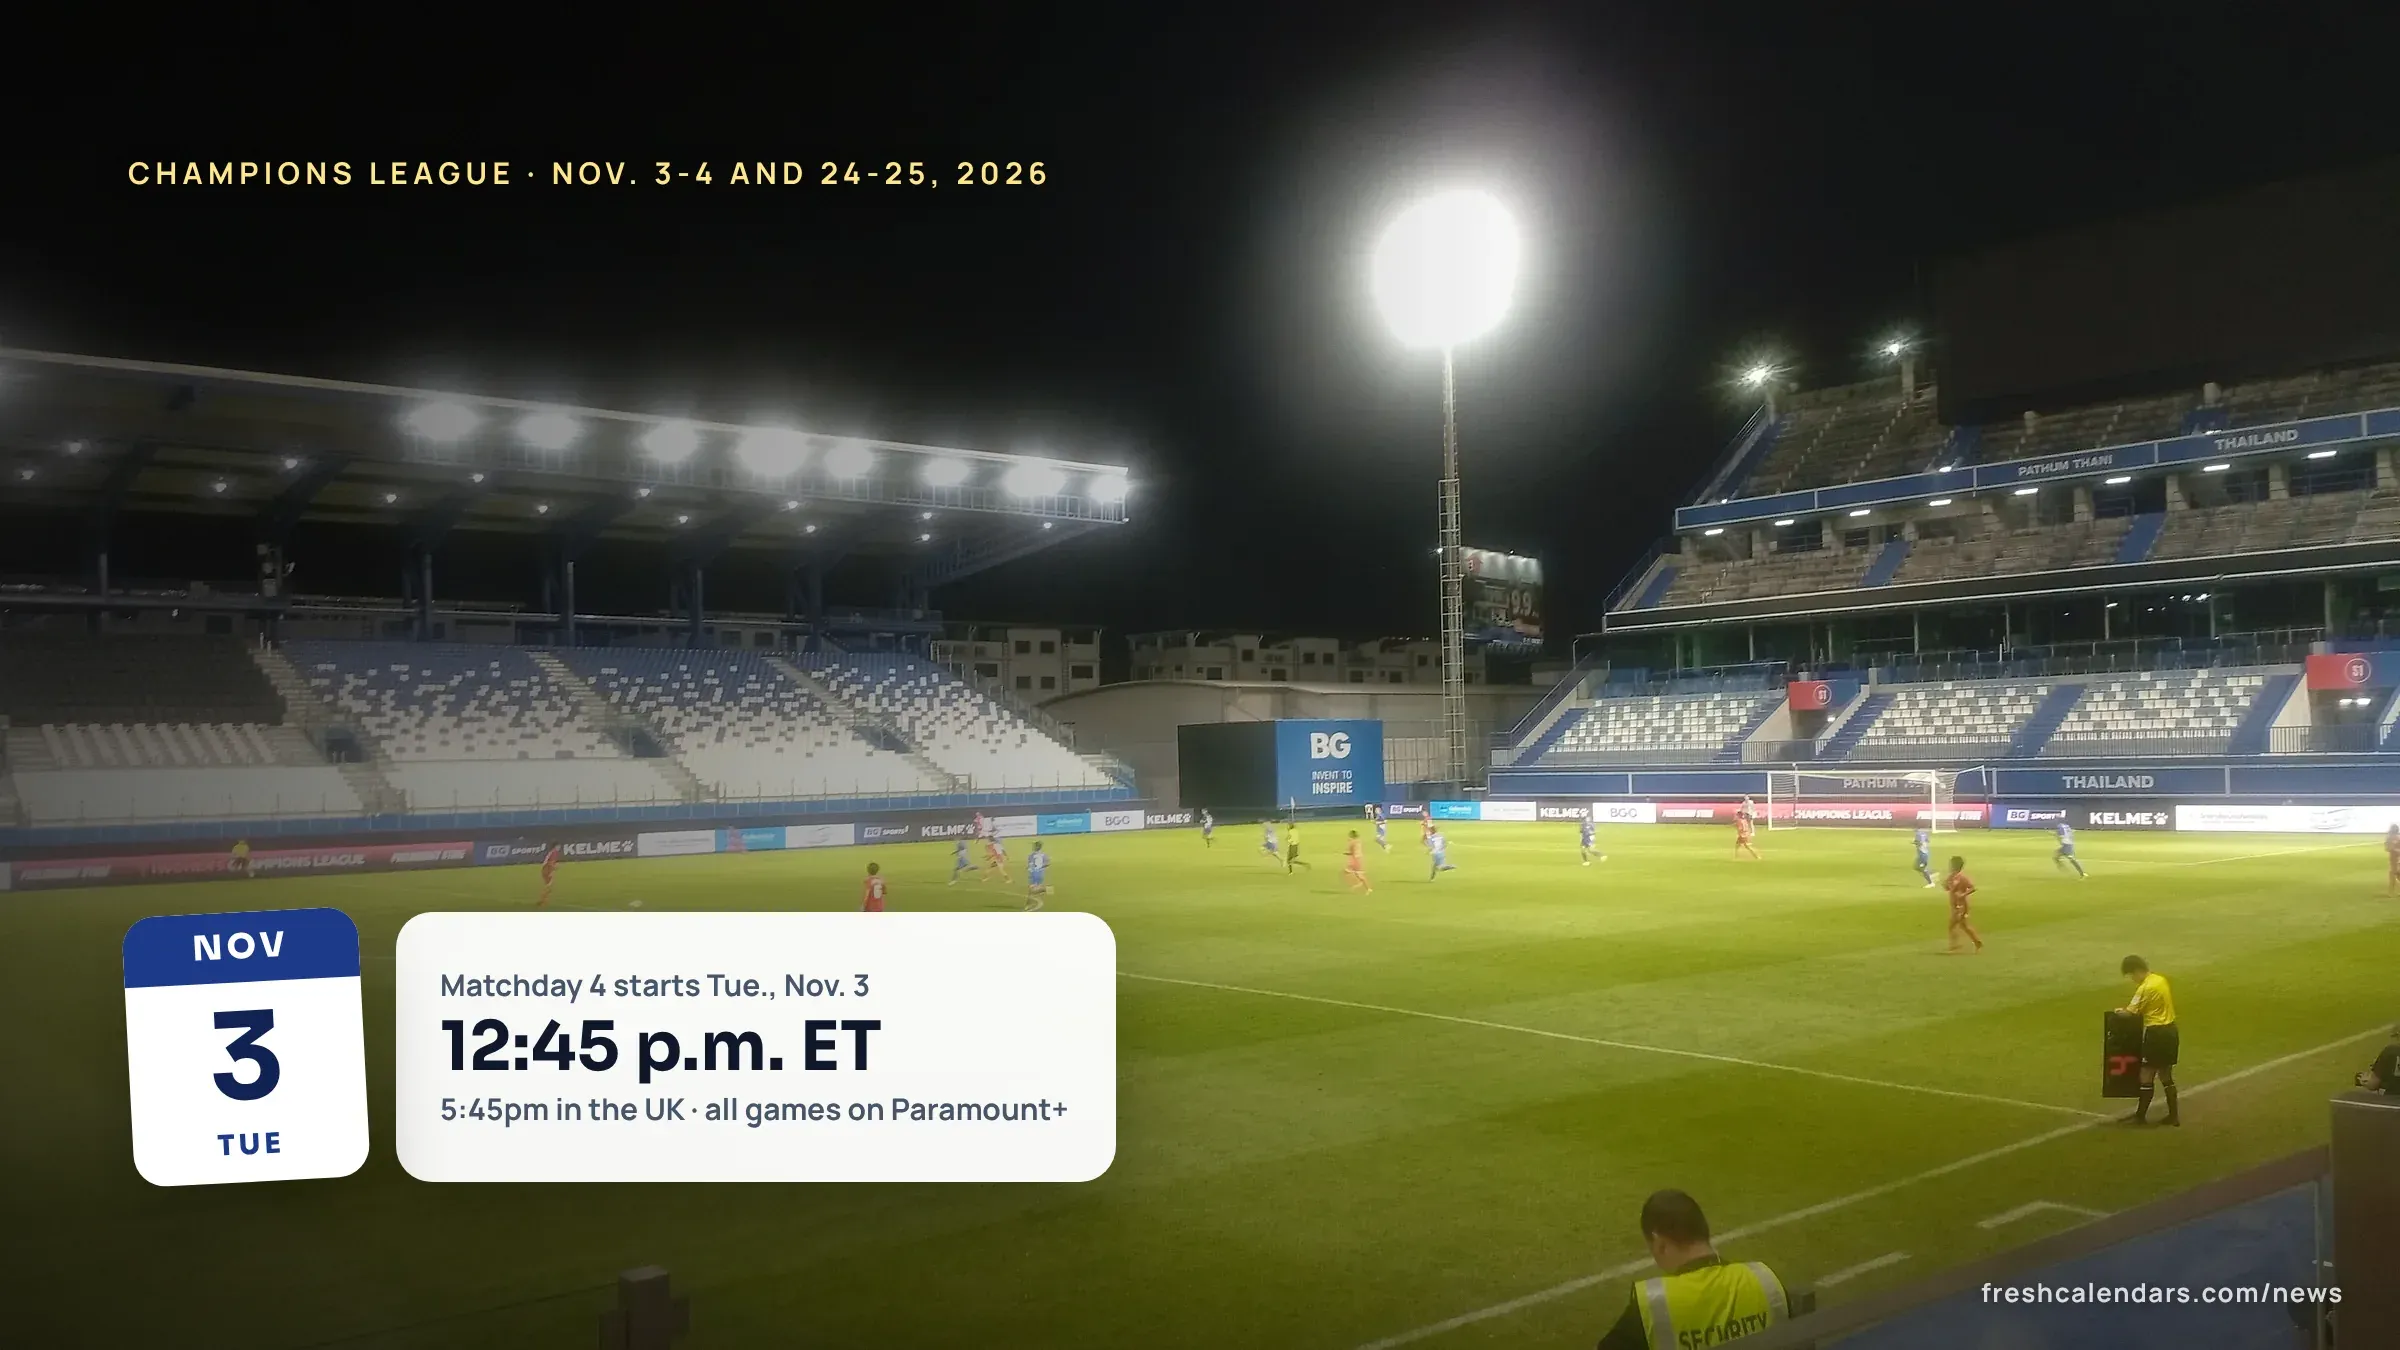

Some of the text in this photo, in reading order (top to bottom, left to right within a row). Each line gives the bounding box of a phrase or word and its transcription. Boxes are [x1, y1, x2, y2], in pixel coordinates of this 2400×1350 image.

[2213, 428, 2299, 451] THAILAND
[2017, 460, 2069, 477] PATHUM
[1310, 732, 1352, 759] BG
[1311, 770, 1353, 781] INVENT TO
[2062, 775, 2154, 789] THAILAND
[1312, 782, 1353, 795] INSPIRE
[1843, 778, 1898, 789] PATHUM
[1146, 812, 1184, 825] KELME
[2009, 810, 2027, 820] BG
[2089, 811, 2153, 825] KELME
[563, 841, 621, 856] KELME
